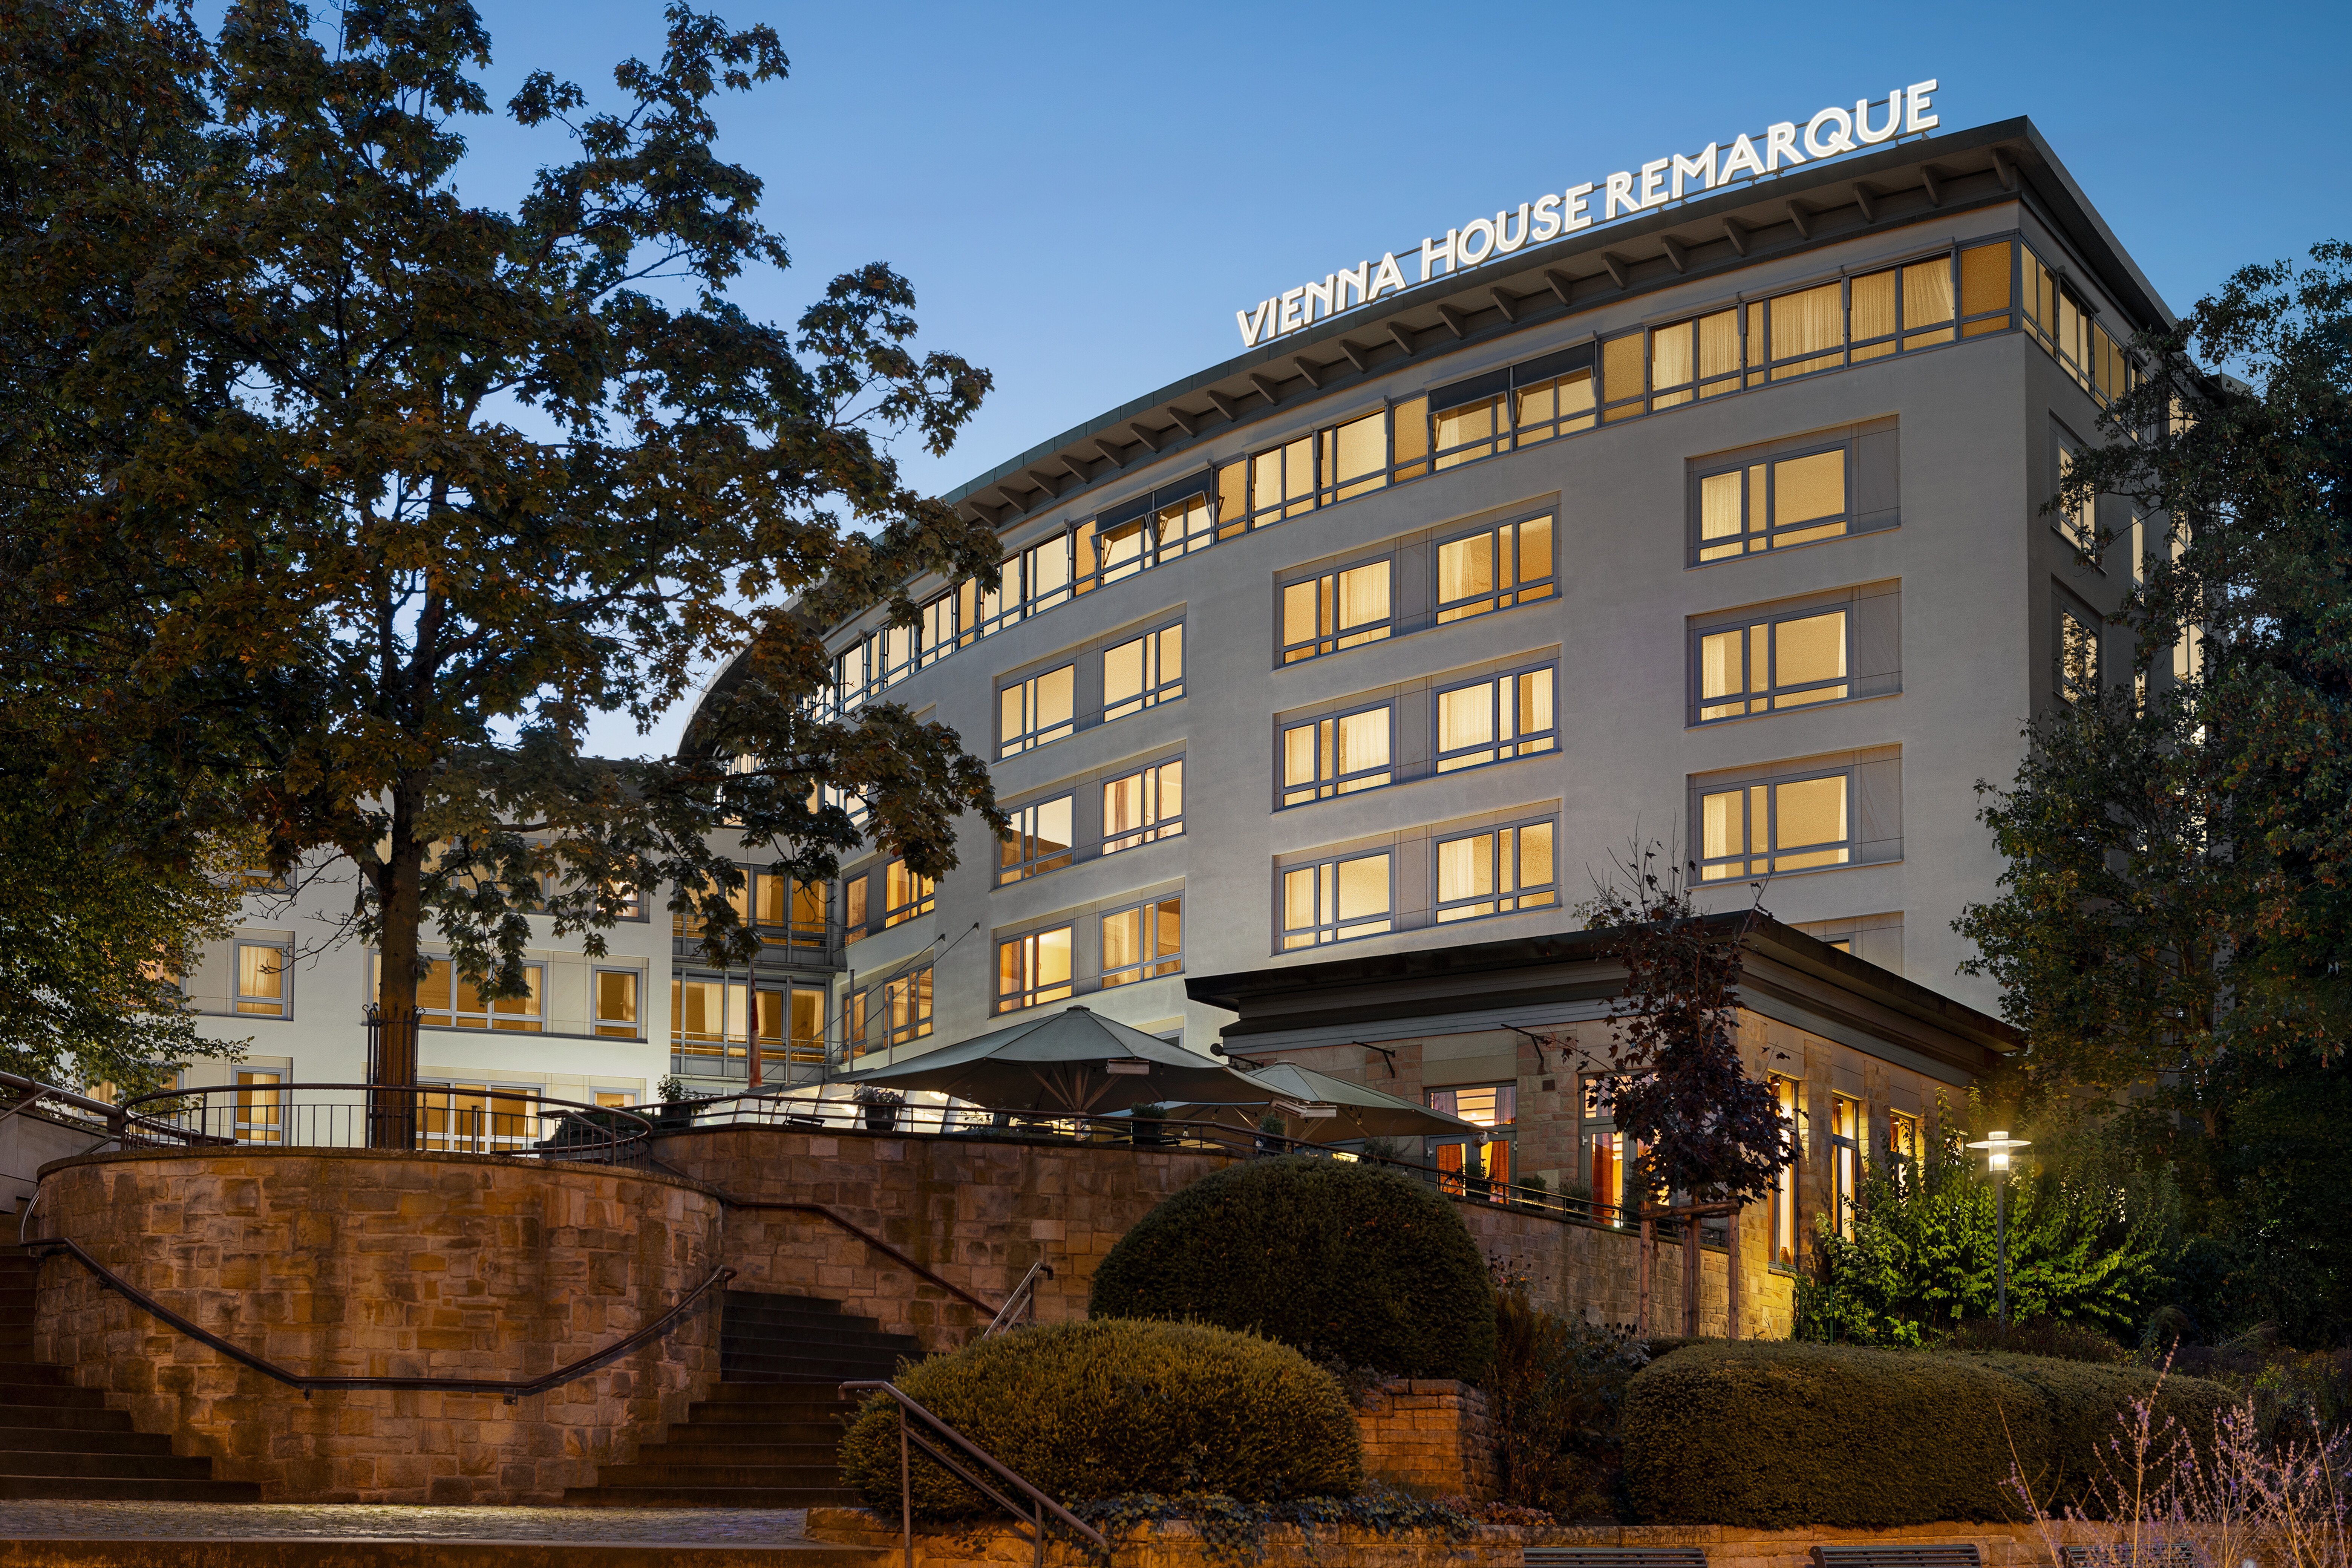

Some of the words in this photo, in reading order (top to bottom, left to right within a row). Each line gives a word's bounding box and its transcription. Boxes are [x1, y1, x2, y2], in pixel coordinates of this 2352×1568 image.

[1236, 252, 1407, 347] VIENNA
[1421, 182, 1594, 281] HOUSE
[1606, 78, 1939, 220] REMARQUE
